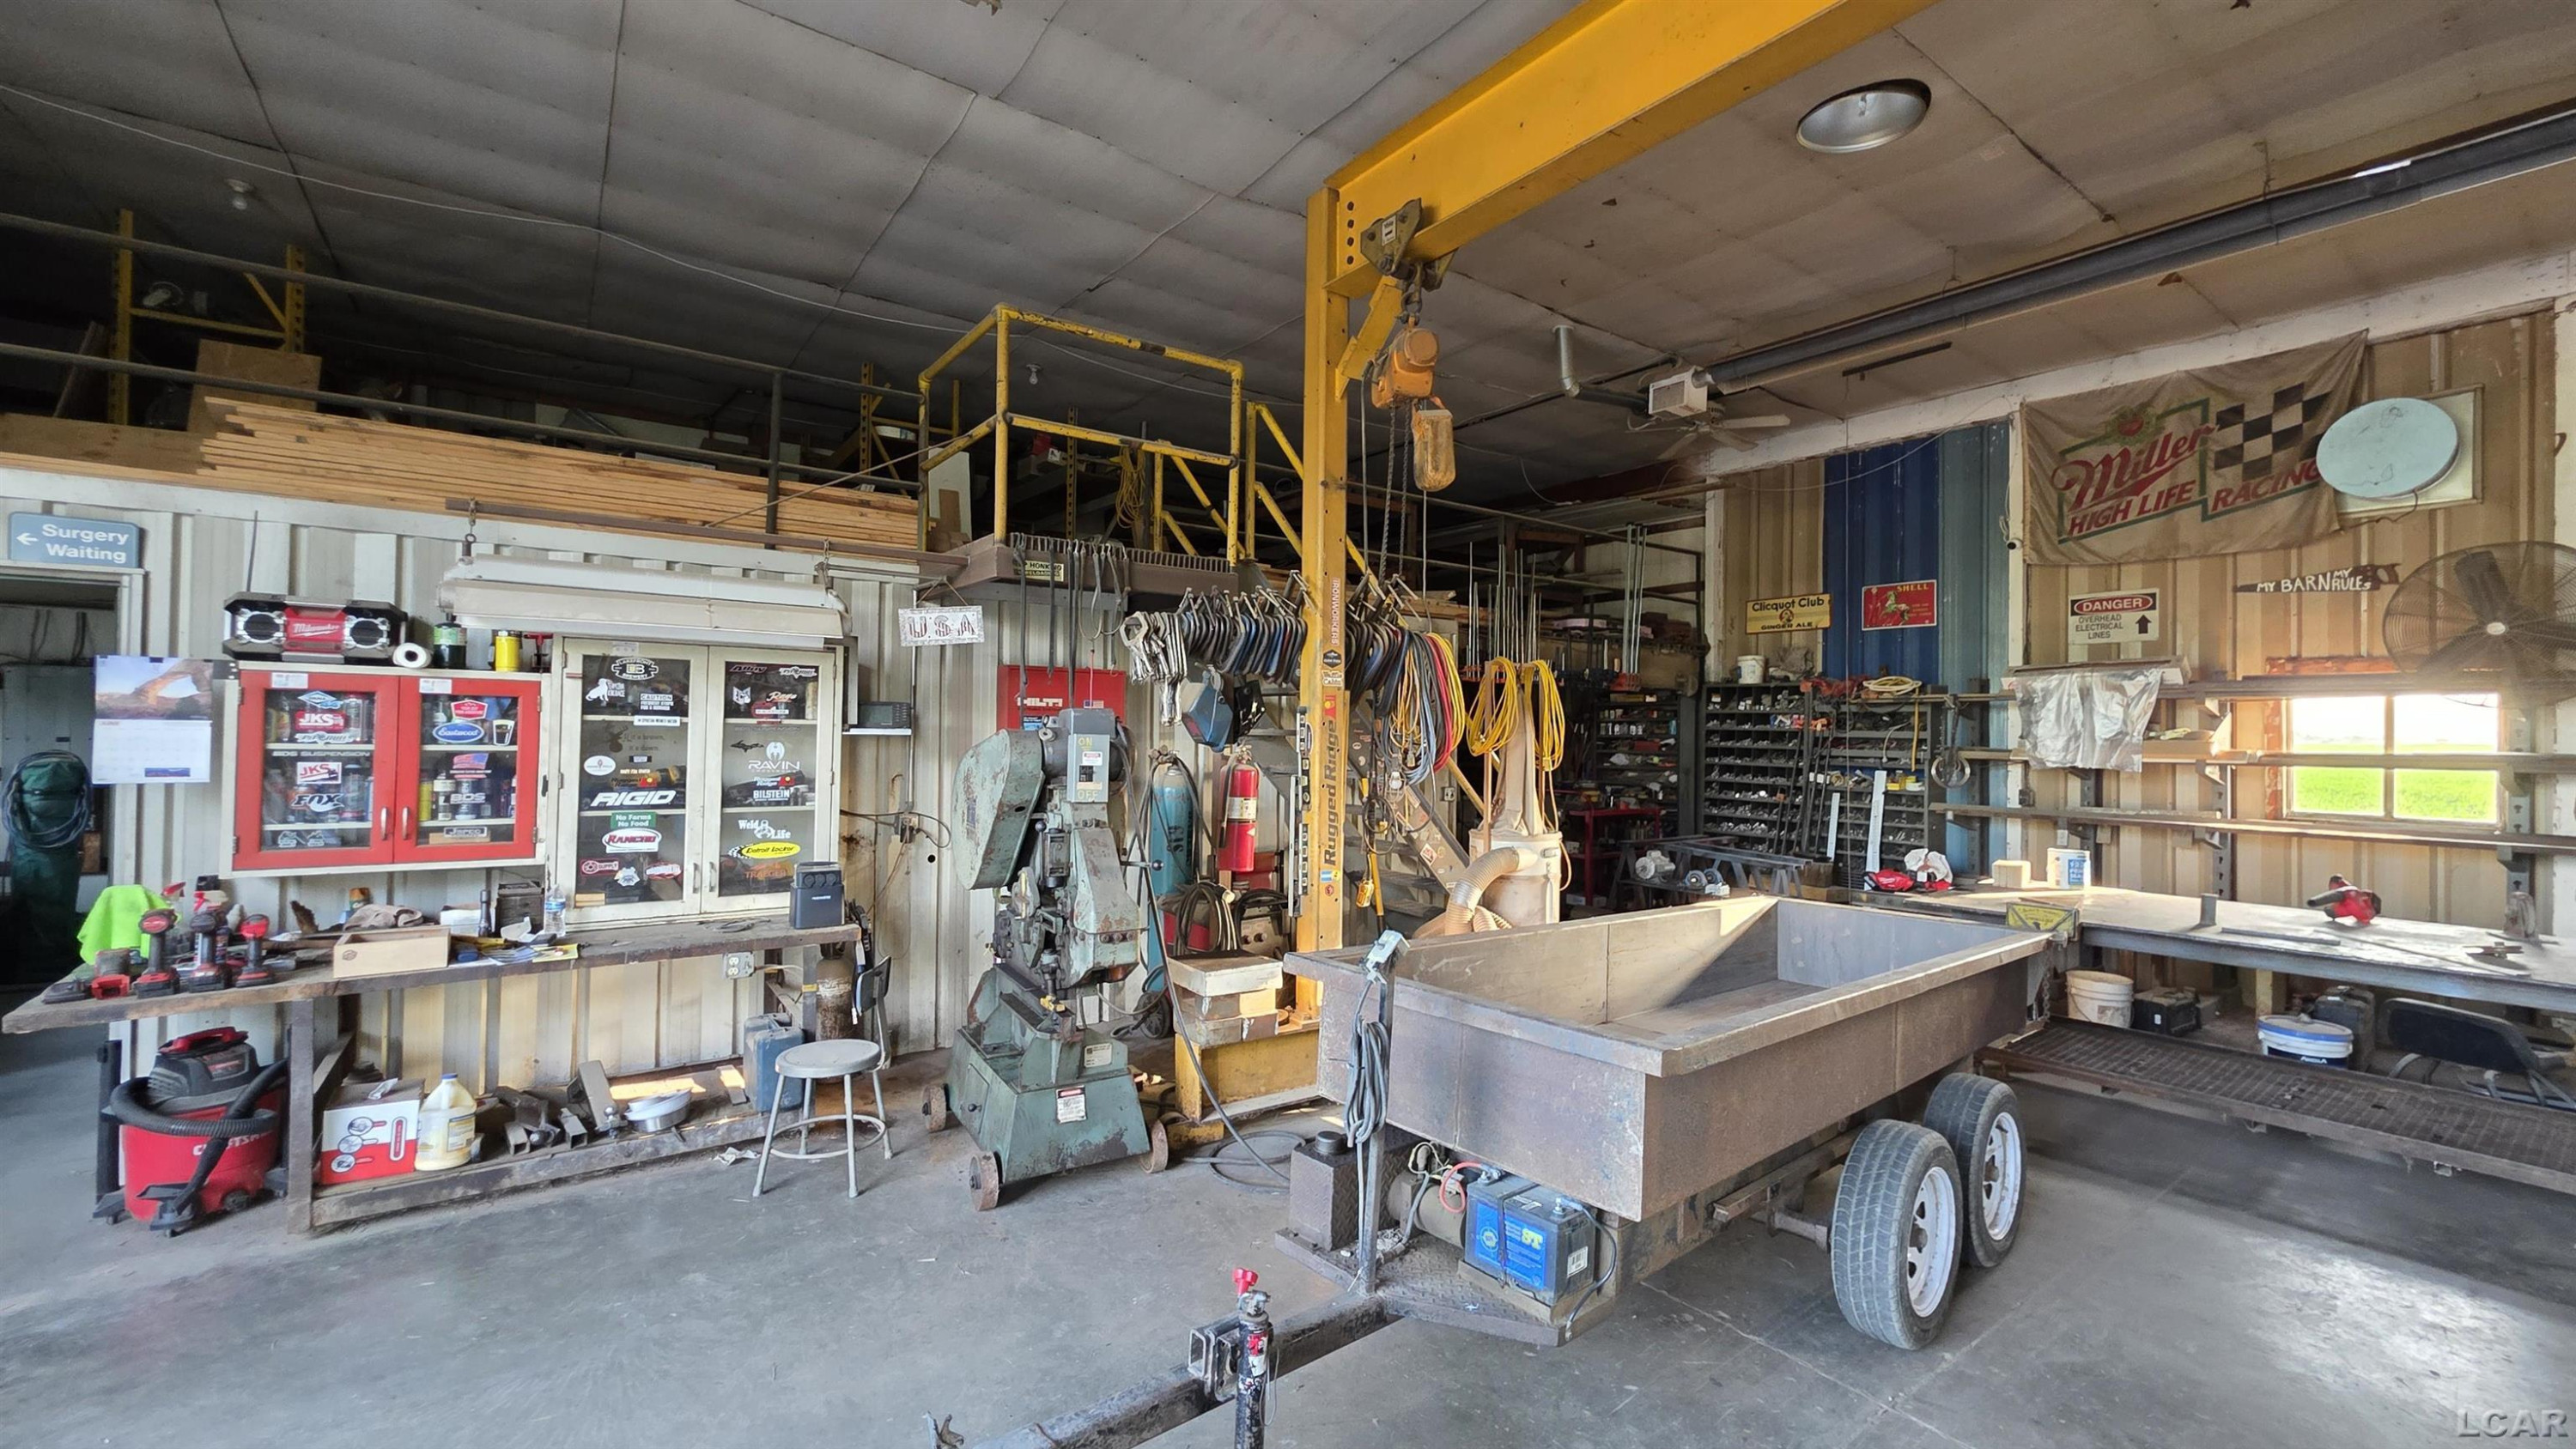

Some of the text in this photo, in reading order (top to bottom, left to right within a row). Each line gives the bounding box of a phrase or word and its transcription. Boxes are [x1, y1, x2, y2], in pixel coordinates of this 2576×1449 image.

[2051, 424, 2216, 512] Miller
[2069, 481, 2196, 536] HIGH LIFE
[42, 524, 130, 544] Surgery
[46, 543, 127, 563] Waiting
[2334, 567, 2353, 578] MY
[1897, 583, 1929, 591] SHELL
[2257, 573, 2332, 593] MY BARN
[1752, 596, 1825, 612] Clicquot Club
[2082, 597, 2143, 611] DANGER
[1332, 578, 1340, 646] IRONWORKERS
[2078, 614, 2123, 623] OVERHEAD
[2075, 621, 2123, 632] ELECTRICAL
[2087, 631, 2111, 640] LINES
[299, 713, 335, 724] JKS
[438, 725, 479, 736] Eastwood
[1078, 737, 1093, 747] ON
[1324, 719, 1340, 781] Ridge
[301, 763, 330, 776] JKS
[748, 761, 800, 770] RAVIN
[590, 790, 677, 807] RIGID
[753, 789, 791, 799] BILSTEIN
[1078, 790, 1098, 799] OFF
[292, 793, 344, 807] FOX
[738, 820, 759, 830] Weld
[1323, 785, 1339, 866] Rugged
[607, 834, 657, 844] RANCHO
[771, 829, 792, 839] Life
